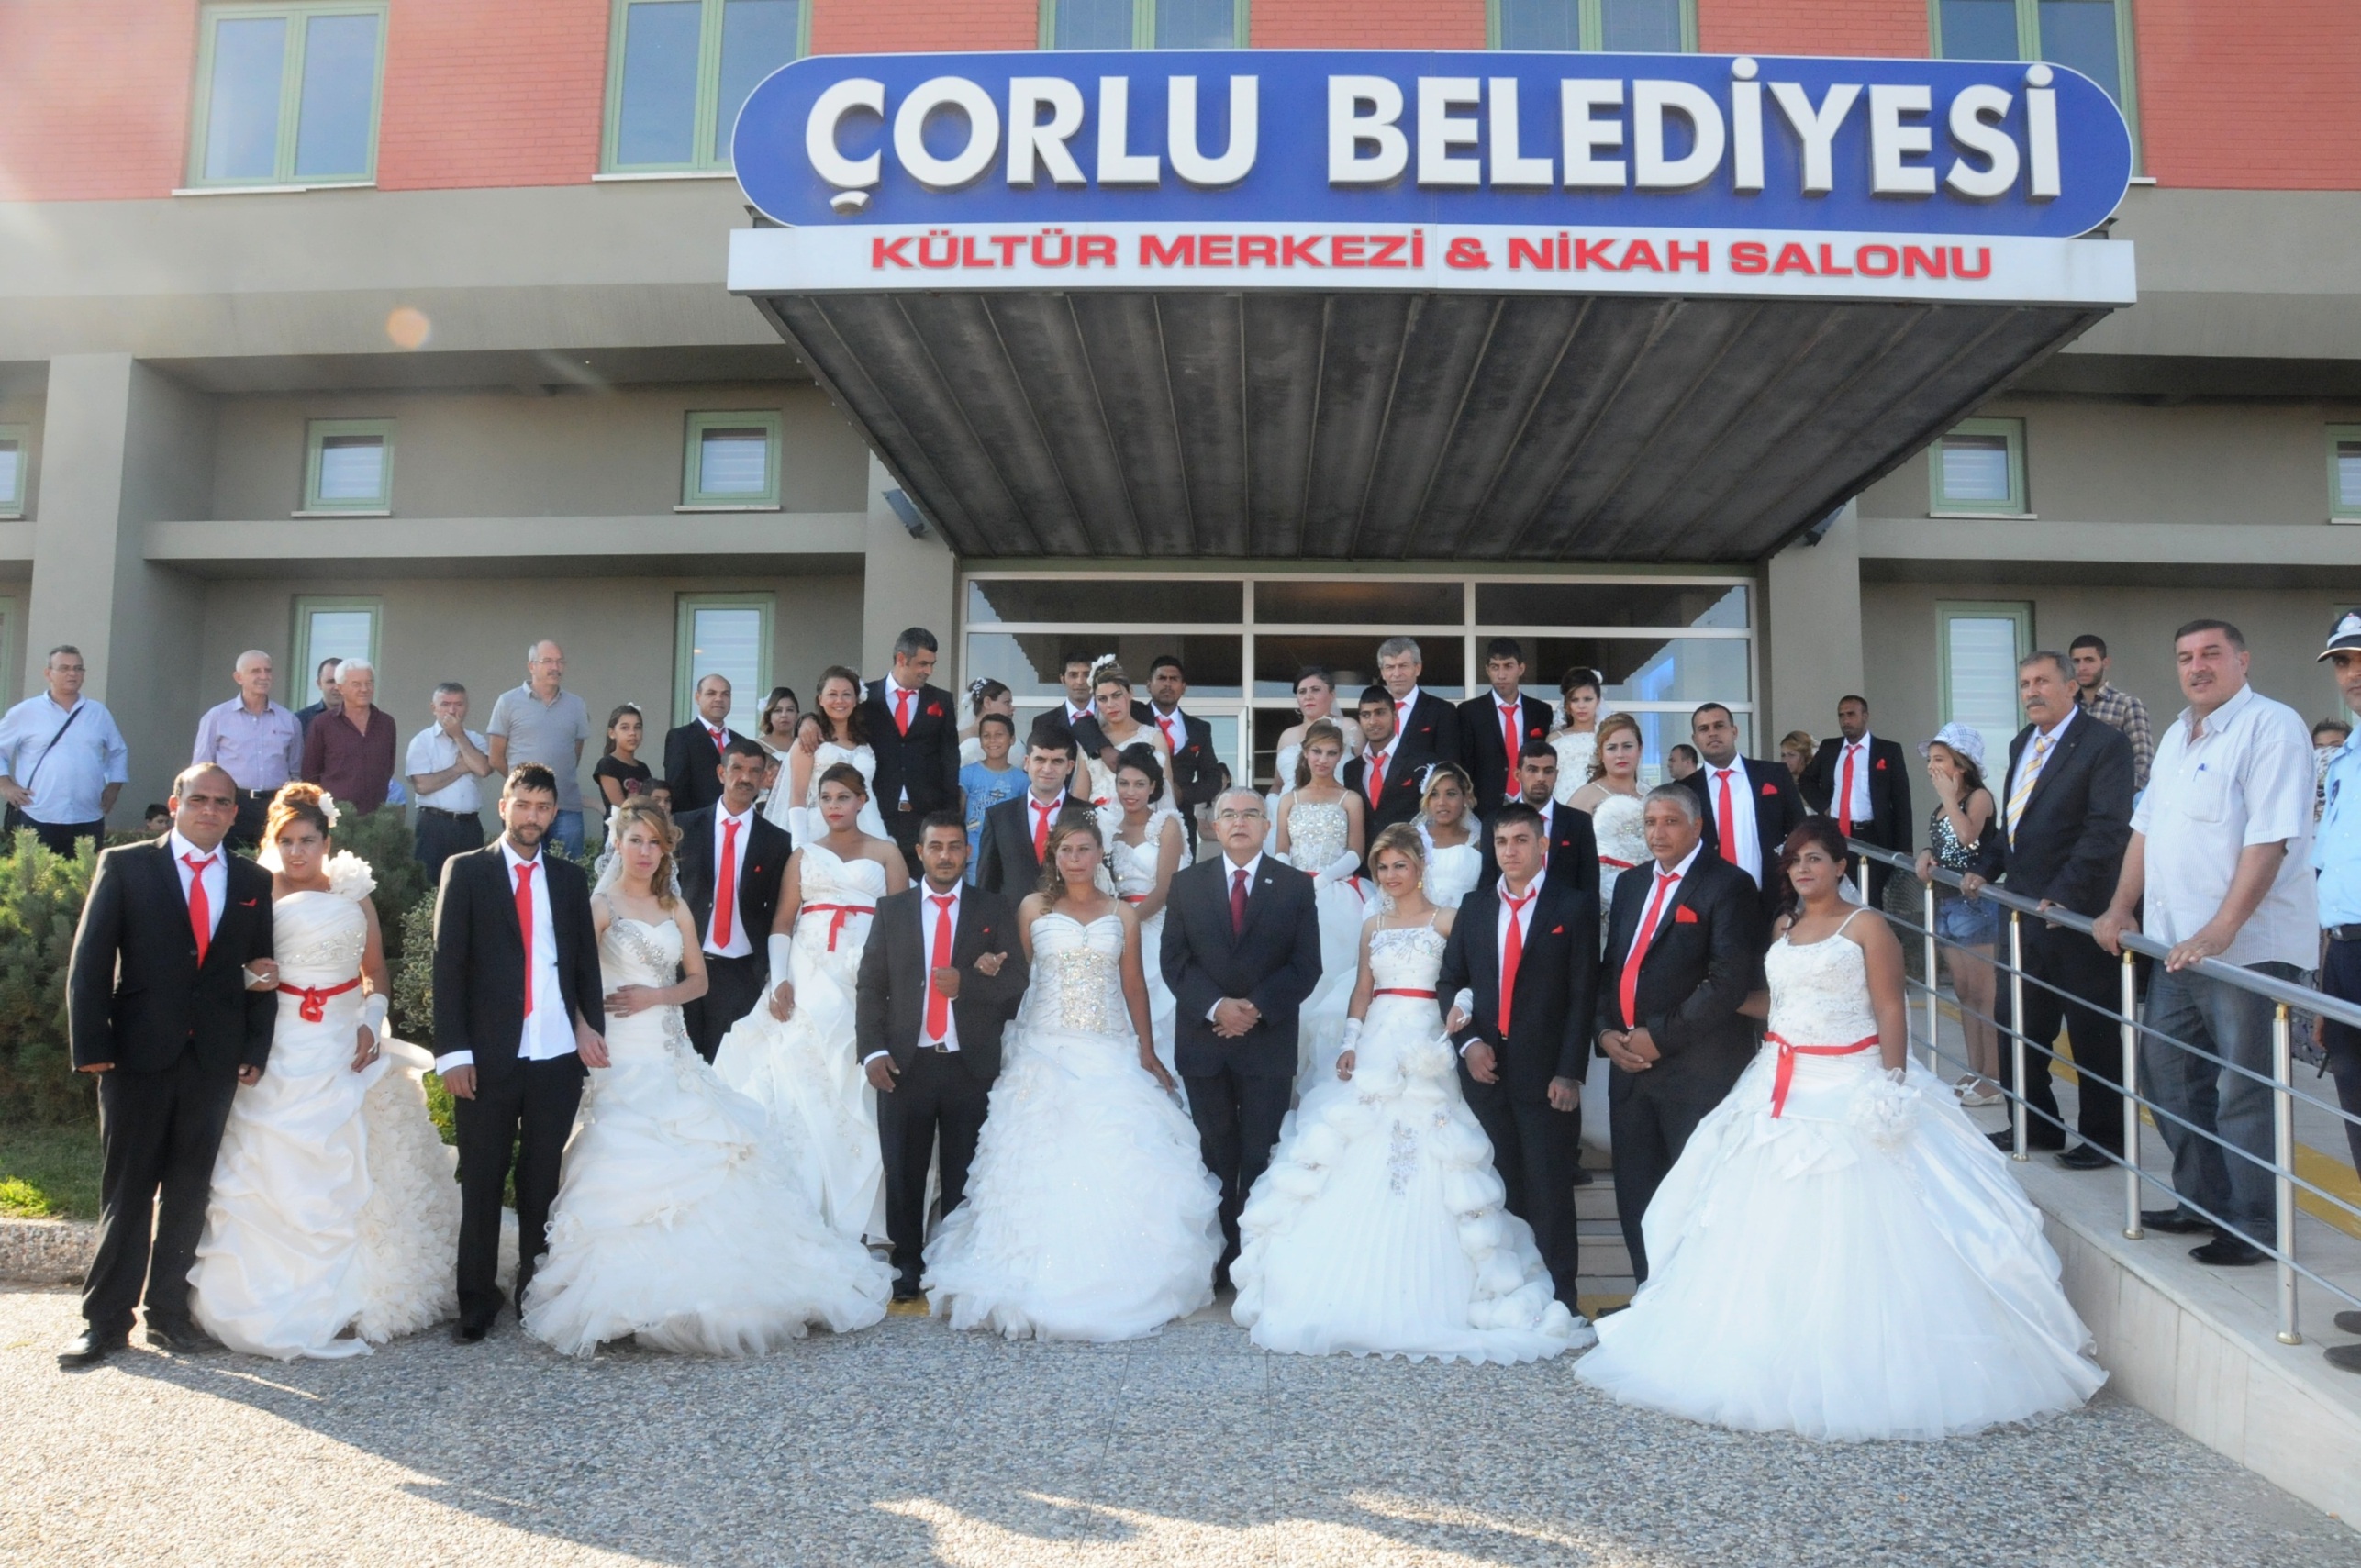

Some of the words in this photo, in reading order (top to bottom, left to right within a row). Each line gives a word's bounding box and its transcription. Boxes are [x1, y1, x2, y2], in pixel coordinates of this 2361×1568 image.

[805, 76, 1258, 214] ÇORLU
[1327, 55, 2062, 201] BELEDİYESİ
[872, 229, 1117, 270] KÜLTÜR
[1139, 228, 1425, 269] MERKEZİ
[1445, 236, 1491, 270] &
[1508, 231, 1710, 273] NİKAH
[1729, 240, 1992, 280] SALONU
